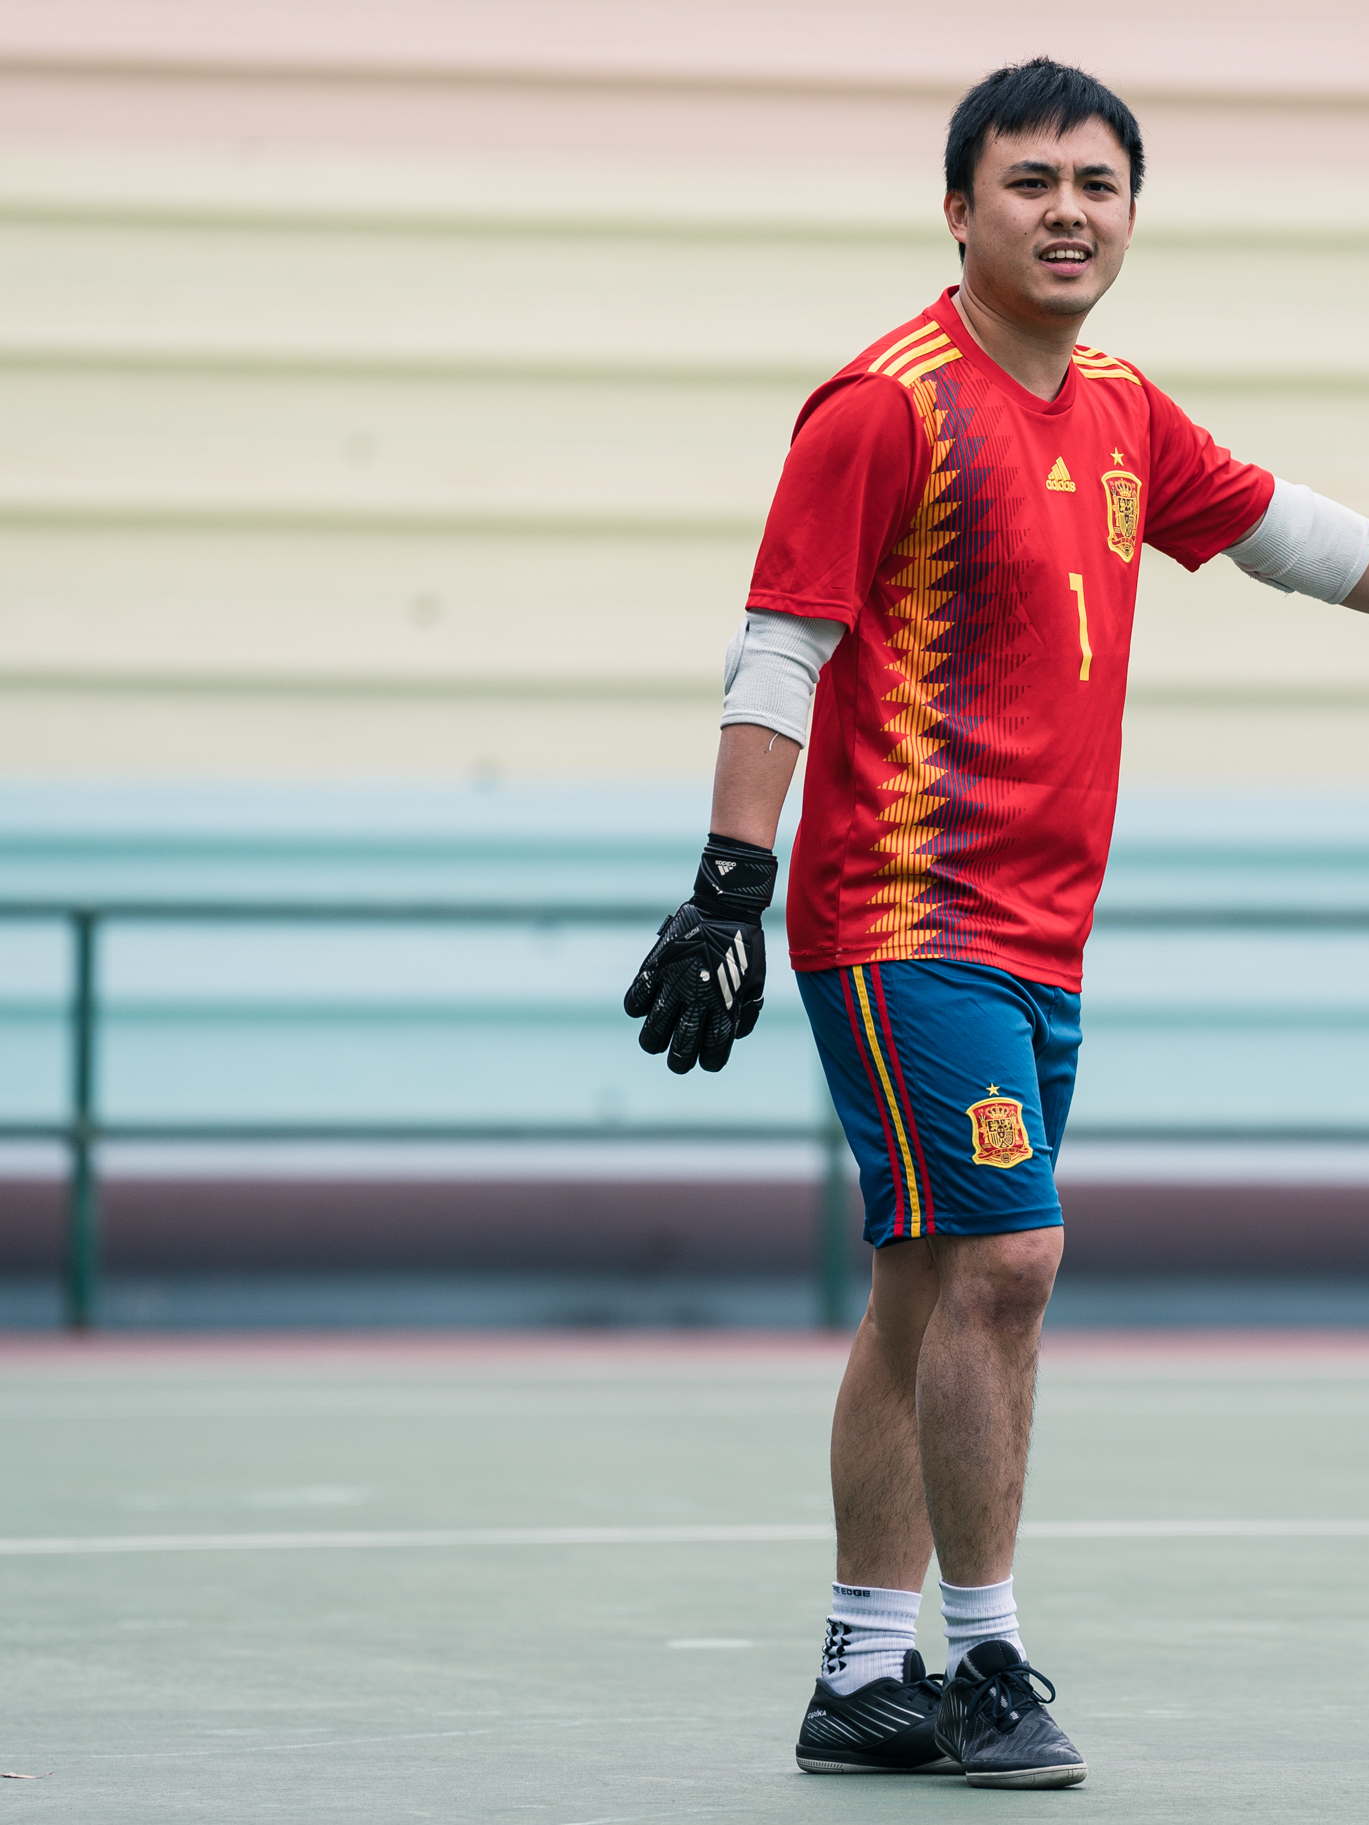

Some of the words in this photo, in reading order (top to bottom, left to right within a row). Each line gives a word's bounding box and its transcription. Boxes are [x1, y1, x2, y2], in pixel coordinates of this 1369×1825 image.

[1046, 480, 1076, 493] adidas
[1069, 572, 1092, 681] 1
[715, 859, 737, 867] adidas
[841, 1587, 870, 1597] EDGE
